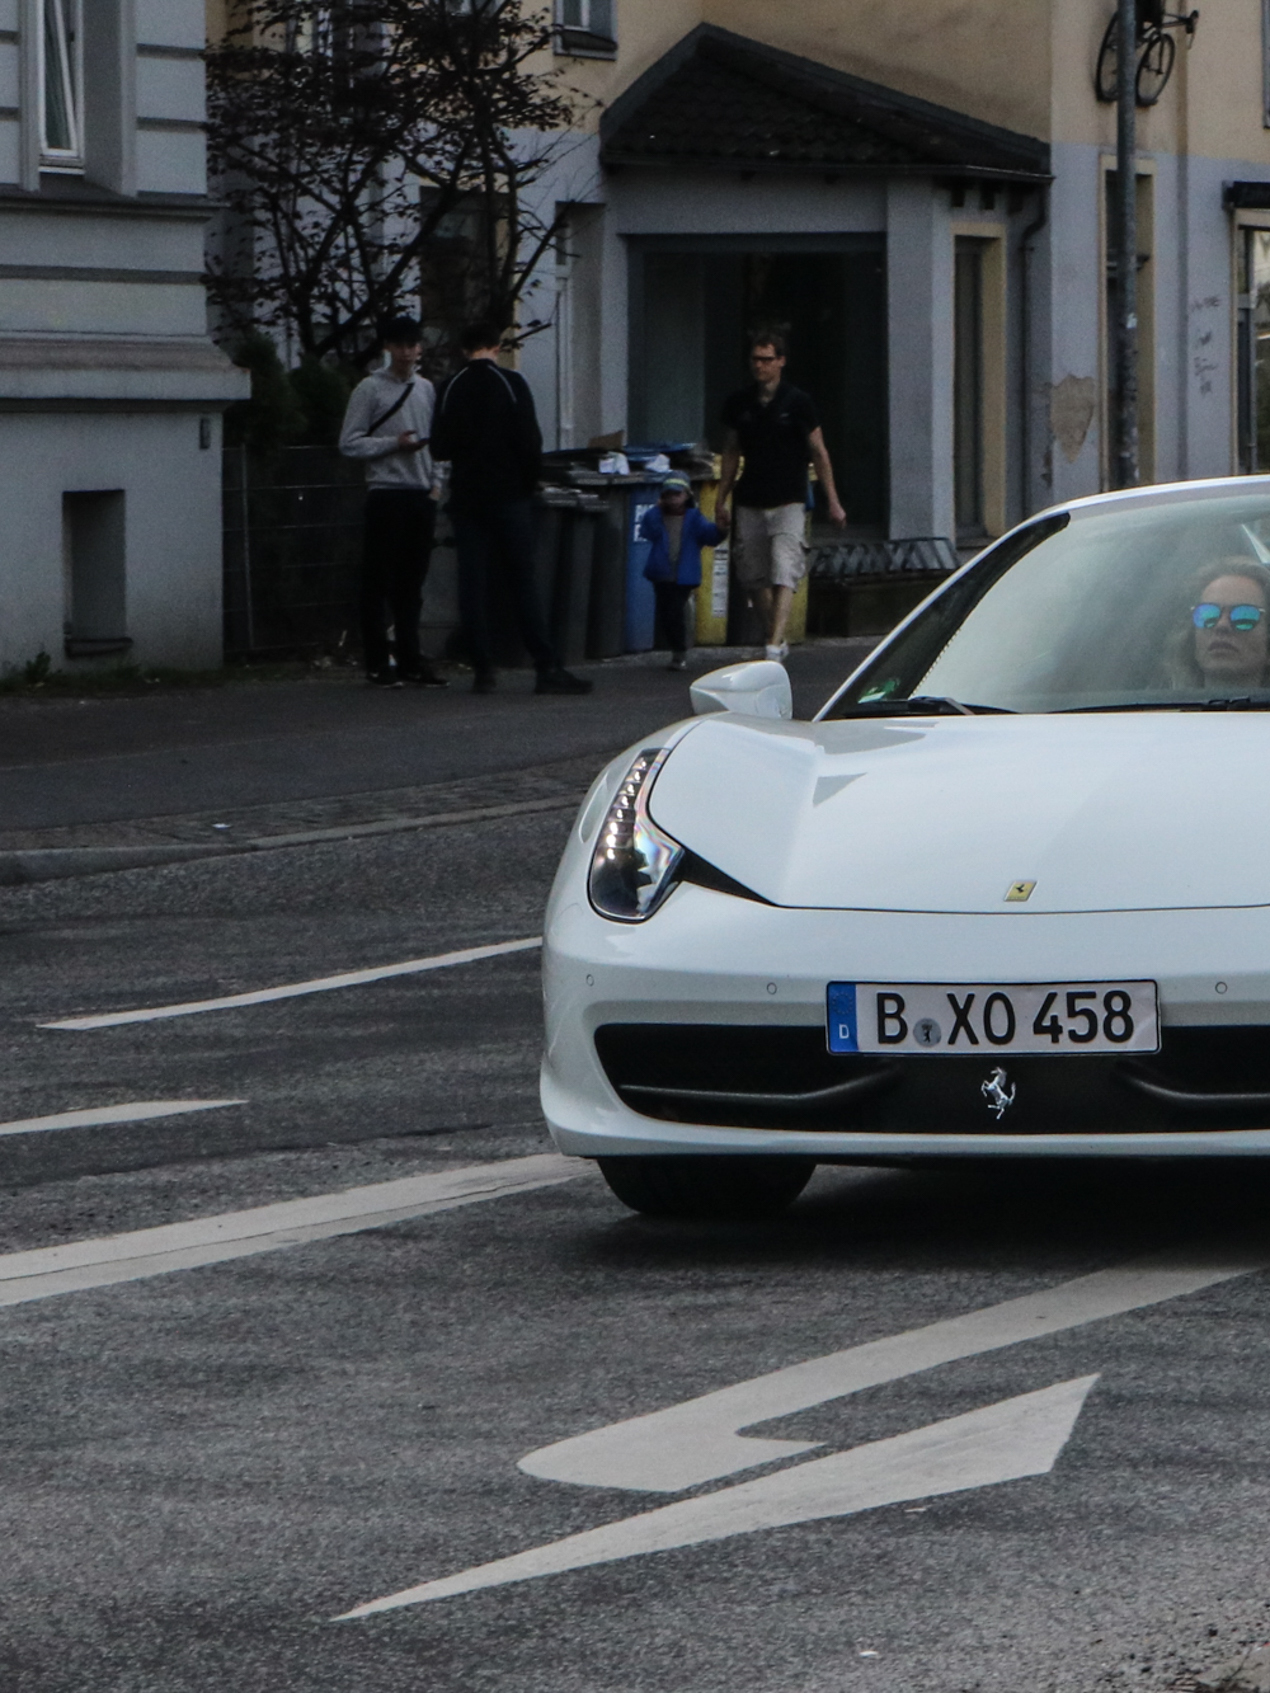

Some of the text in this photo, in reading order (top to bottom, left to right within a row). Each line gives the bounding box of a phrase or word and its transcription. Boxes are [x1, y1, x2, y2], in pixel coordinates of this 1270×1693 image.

[838, 1024, 849, 1039] D
[876, 989, 1134, 1045] B XO 458
